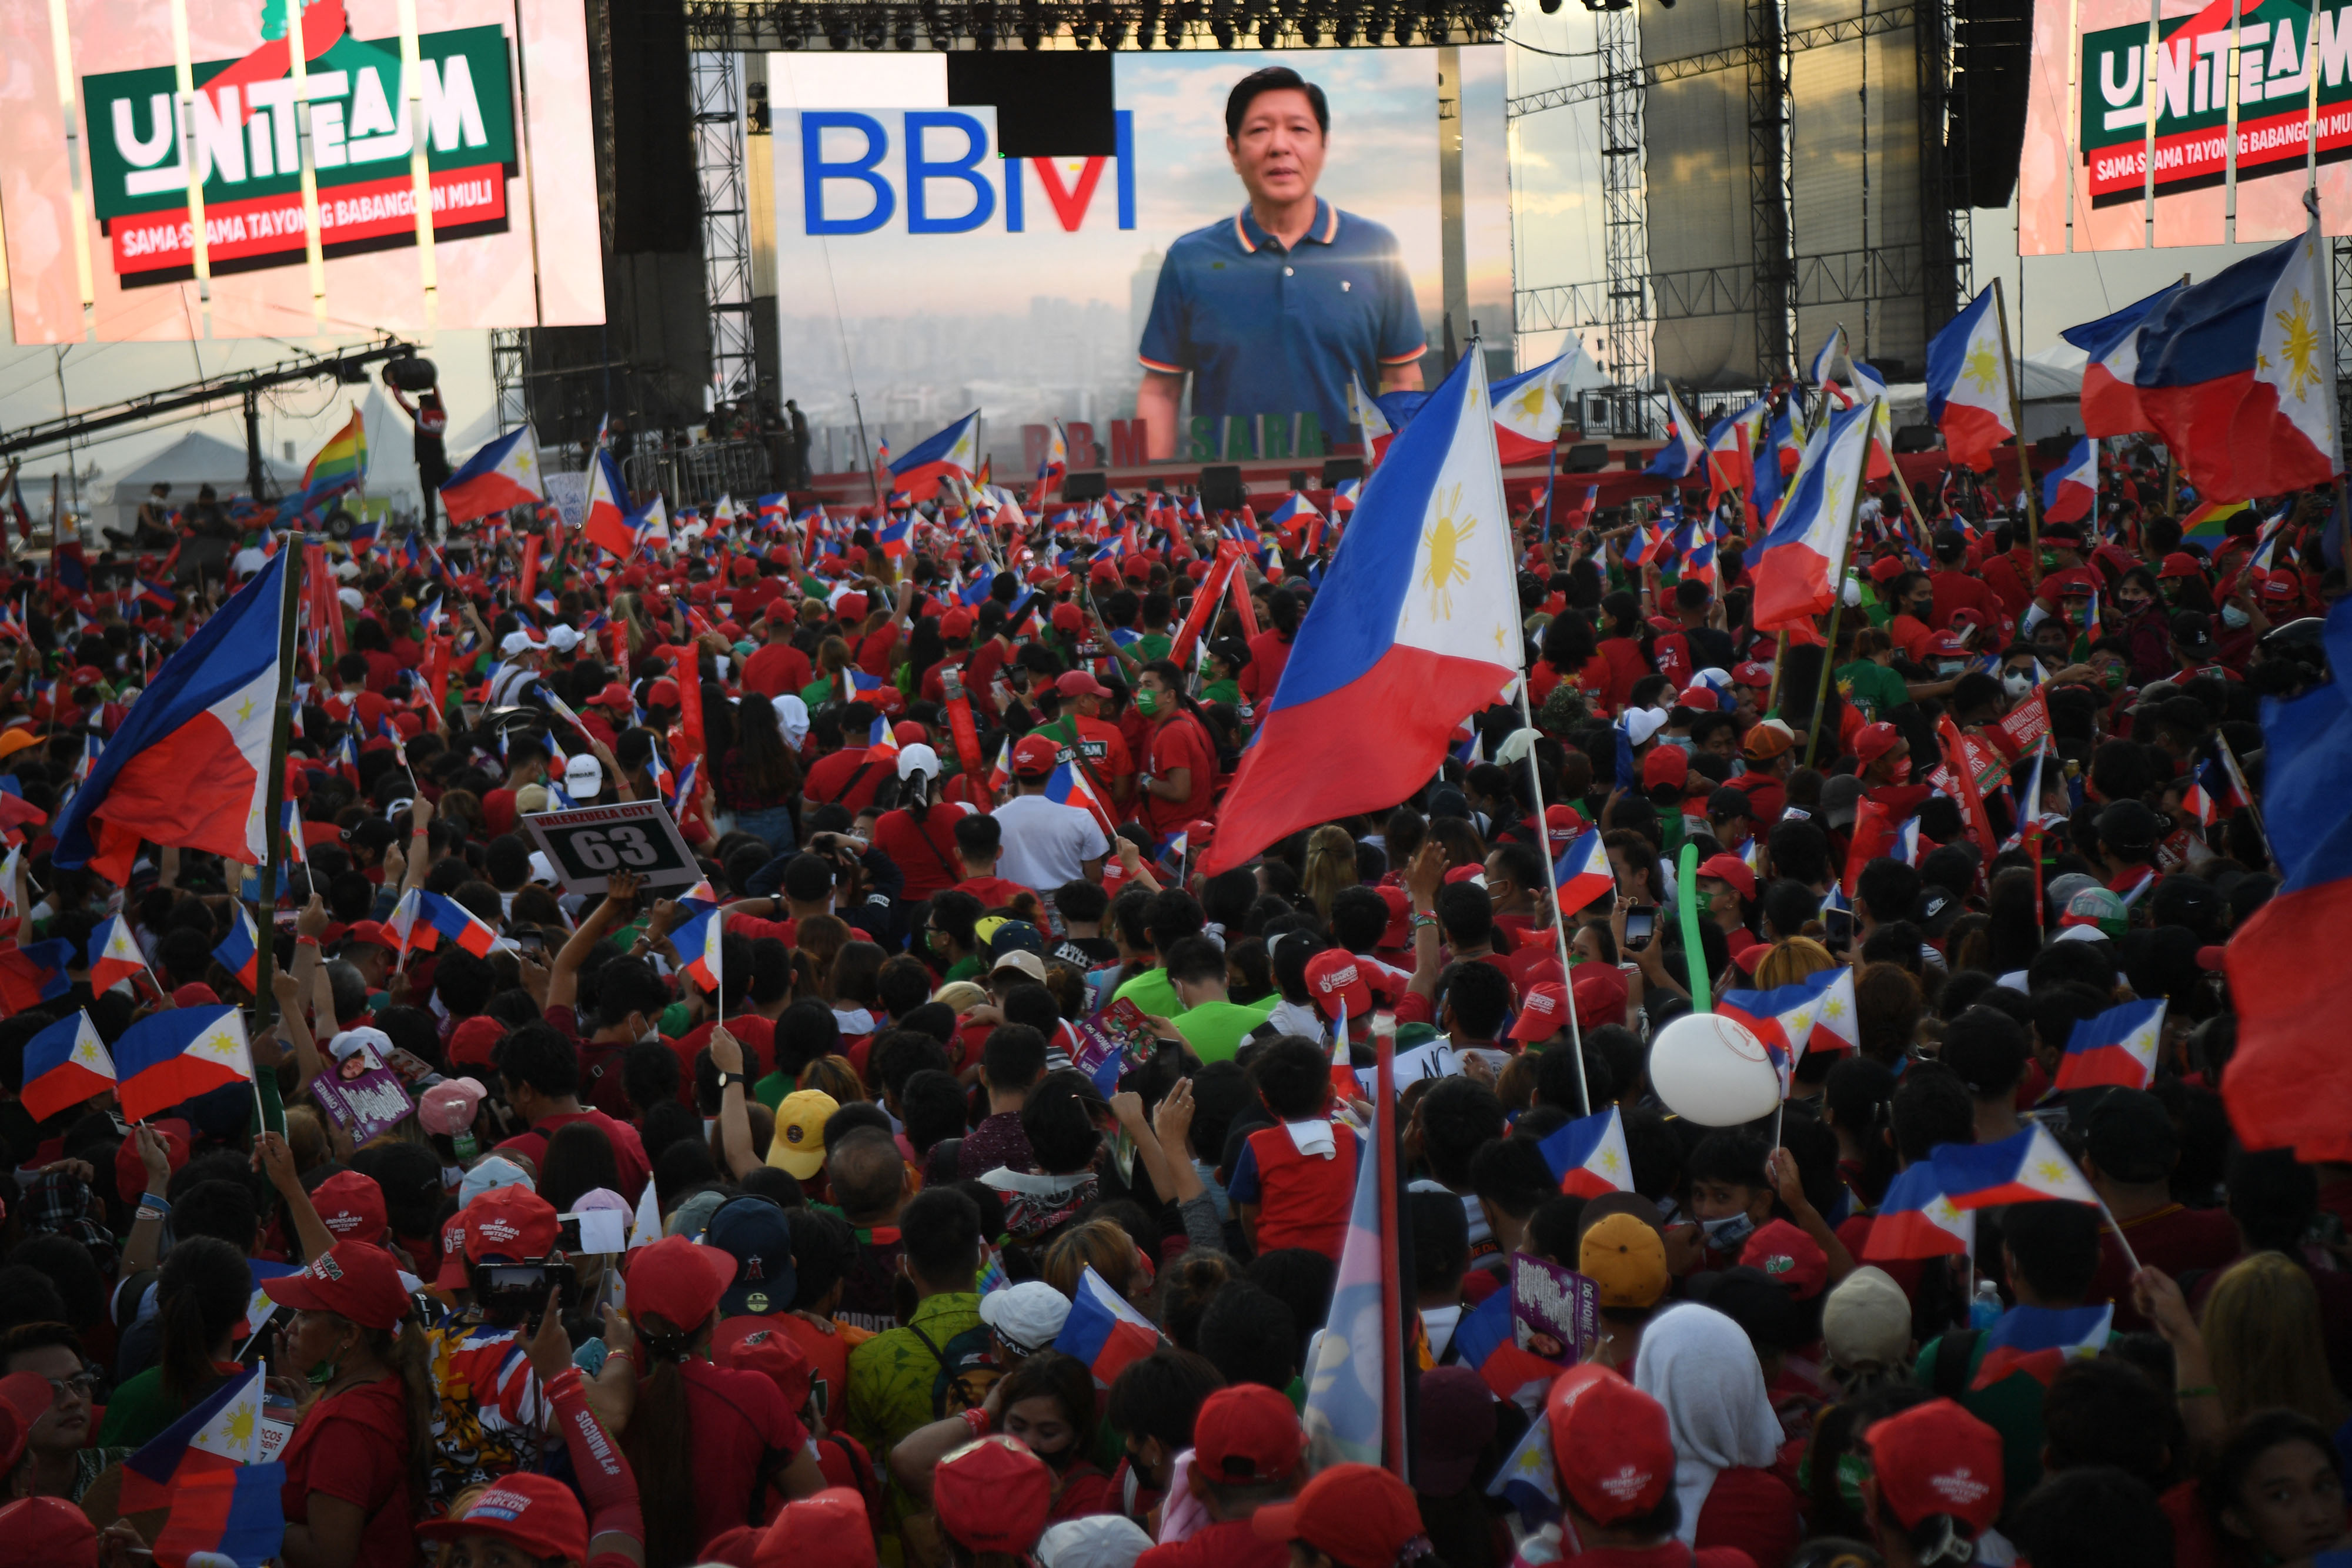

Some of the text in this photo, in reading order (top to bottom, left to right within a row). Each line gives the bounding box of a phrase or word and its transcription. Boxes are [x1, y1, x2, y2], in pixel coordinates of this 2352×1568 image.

[2330, 112, 2352, 136] MU
[449, 178, 492, 208] MULI
[801, 110, 1135, 235] BBM
[1189, 411, 1324, 463] SARA
[534, 805, 654, 827] VALENZUELA CITY
[569, 825, 659, 870] 63
[313, 1080, 339, 1109] OWNER
[1581, 1283, 1594, 1333] 06 HOME
[575, 1410, 612, 1460] MARCOS
